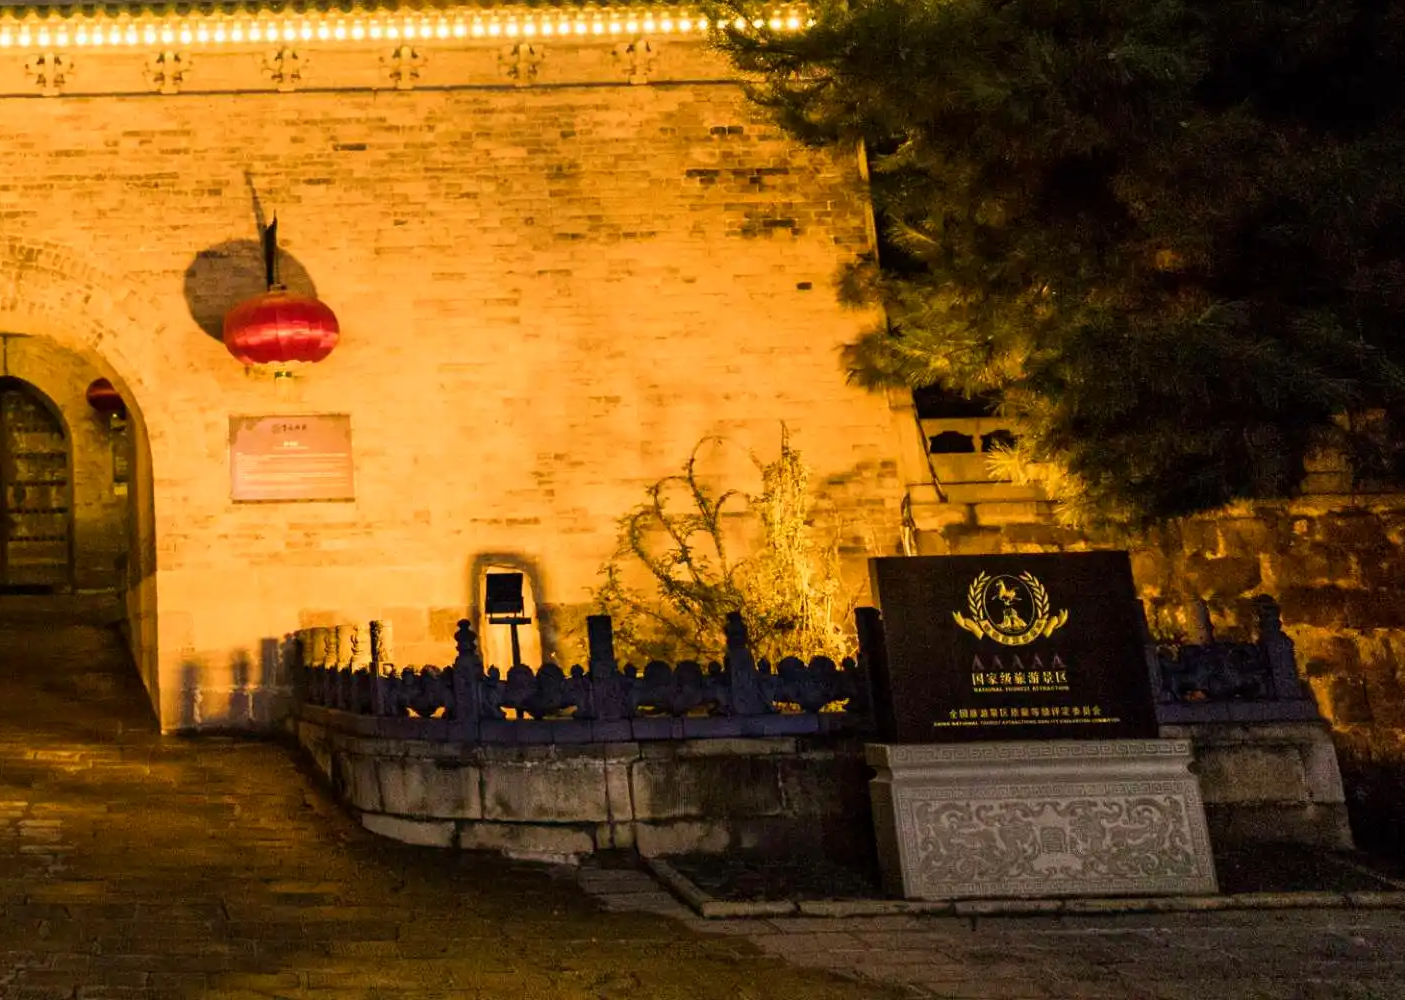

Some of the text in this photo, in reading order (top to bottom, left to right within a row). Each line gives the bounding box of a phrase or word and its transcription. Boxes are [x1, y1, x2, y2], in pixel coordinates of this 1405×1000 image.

[971, 670, 1068, 686] 国家级旅游景区
